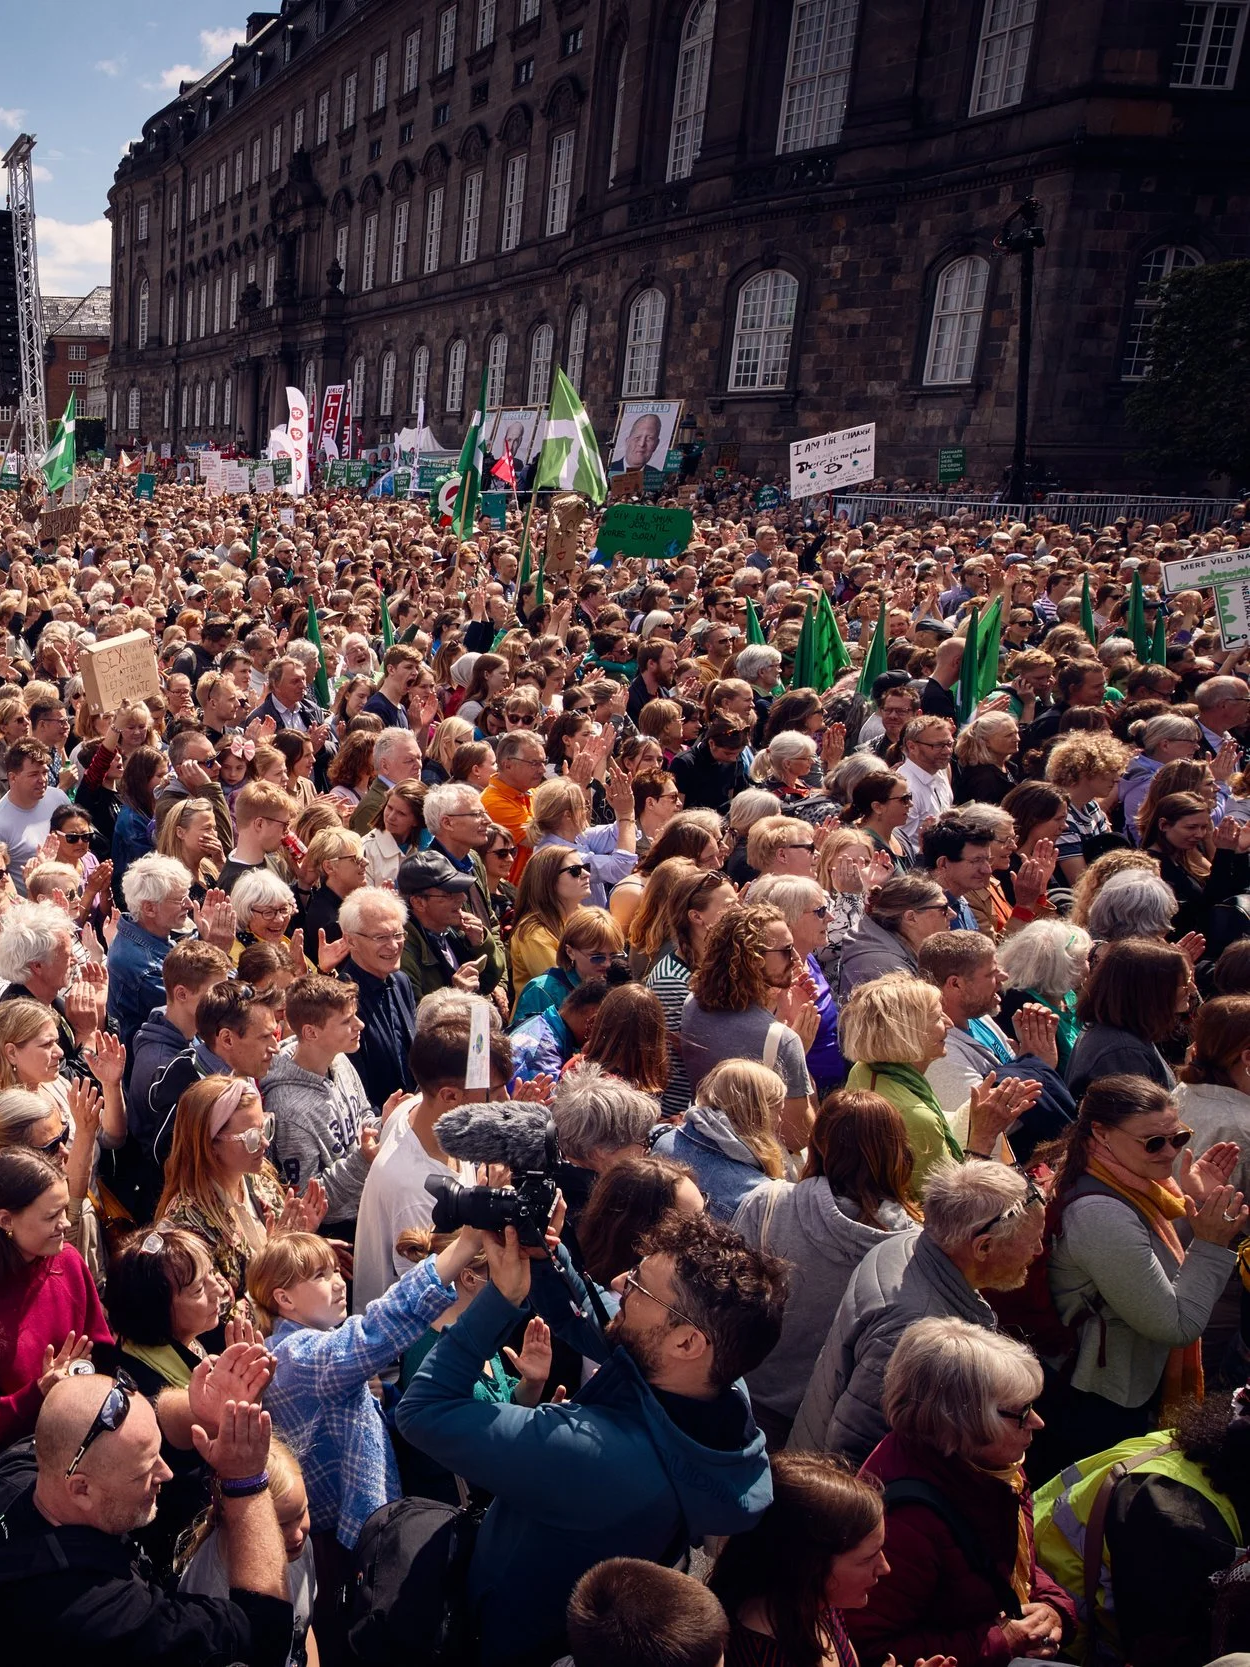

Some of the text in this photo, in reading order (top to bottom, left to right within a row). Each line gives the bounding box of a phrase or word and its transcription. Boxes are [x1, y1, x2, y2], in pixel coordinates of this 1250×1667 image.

[626, 403, 670, 413] UNDSKYLD
[794, 445, 802, 456] I
[805, 441, 820, 453] AM
[824, 463, 842, 474] B
[635, 513, 646, 522] EN
[652, 514, 674, 524] SMUK
[629, 521, 670, 532] JORD TIL
[602, 530, 626, 538] VORES
[1180, 561, 1206, 571] MERE
[1210, 556, 1233, 565] VILD
[97, 648, 125, 673] SEX
[120, 661, 152, 676] ATTENTION
[126, 674, 143, 683] TALK
[112, 680, 150, 704] CLIMATE
